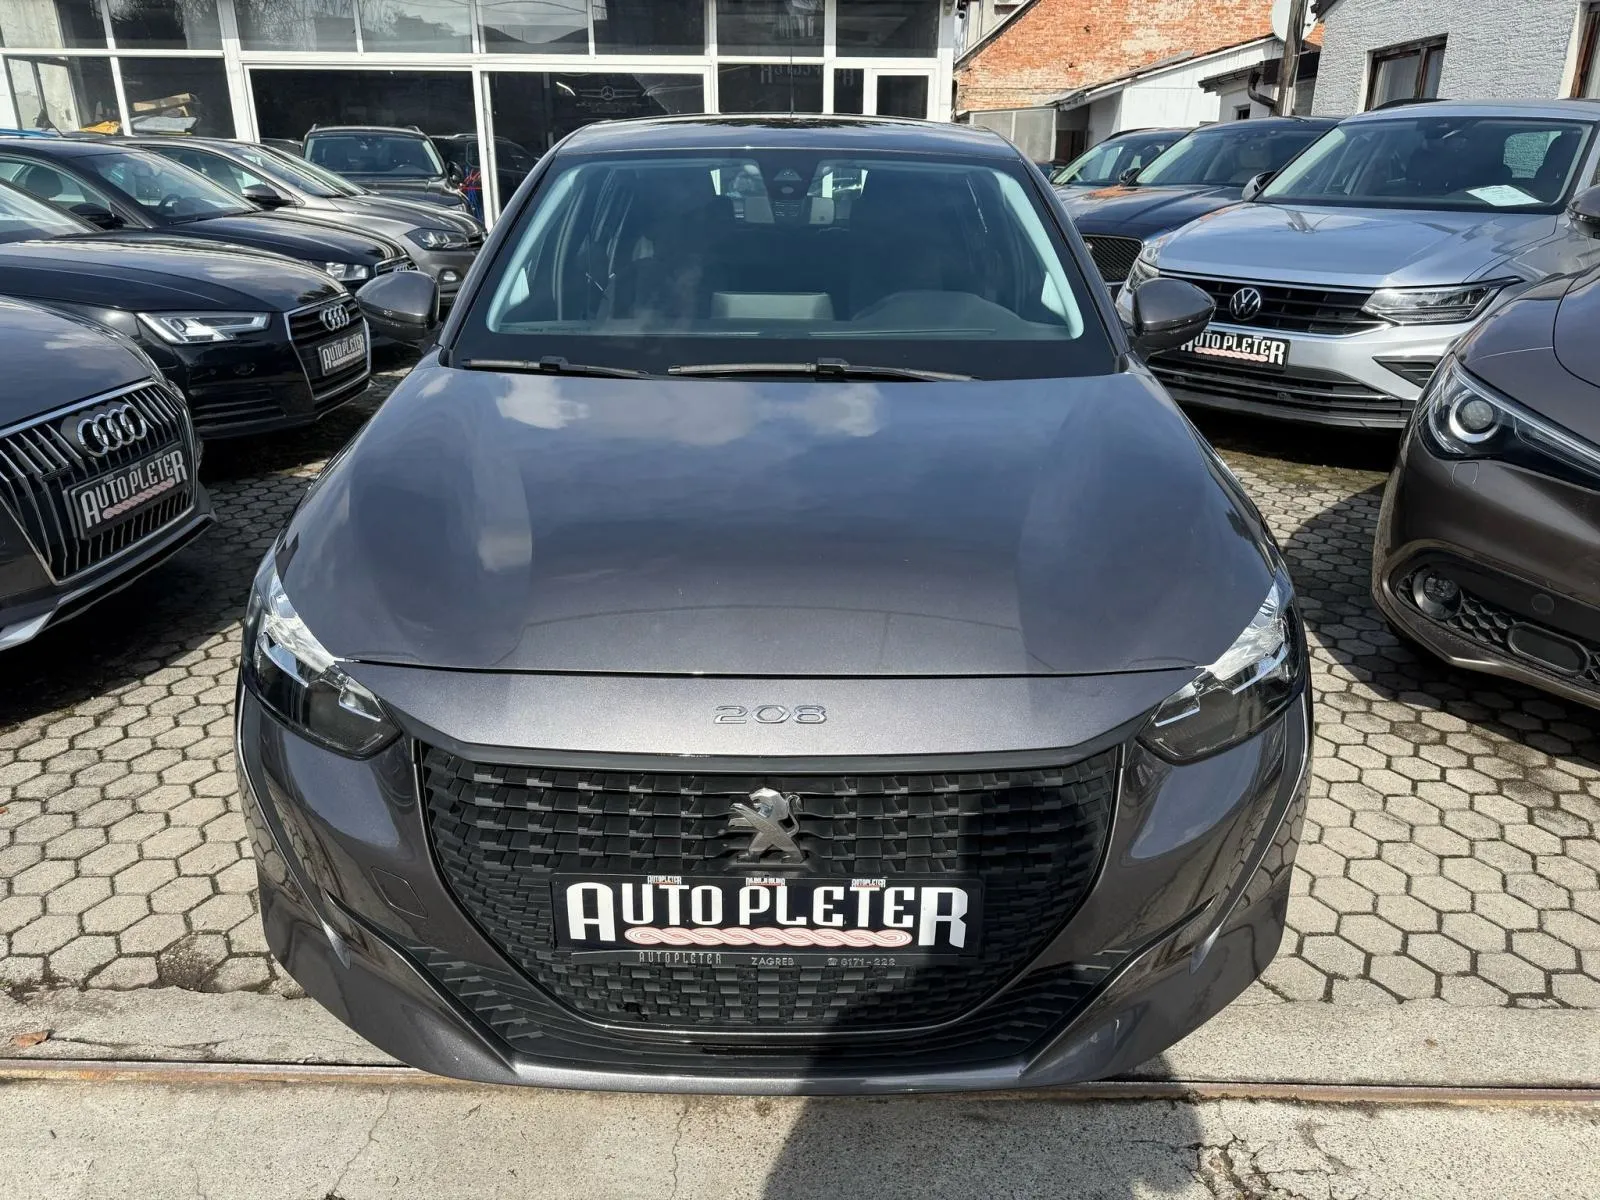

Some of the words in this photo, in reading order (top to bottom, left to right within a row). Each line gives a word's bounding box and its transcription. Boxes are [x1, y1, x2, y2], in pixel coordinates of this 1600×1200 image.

[322, 344, 343, 370] AUTO
[342, 333, 366, 356] PLETER
[1222, 334, 1286, 365] PLETER
[80, 476, 129, 529] AUTO
[129, 450, 188, 495] PLETER
[713, 704, 828, 725] 208
[565, 881, 723, 942] AUTO
[738, 885, 969, 949] PLETER
[751, 956, 795, 966] ZAGREB
